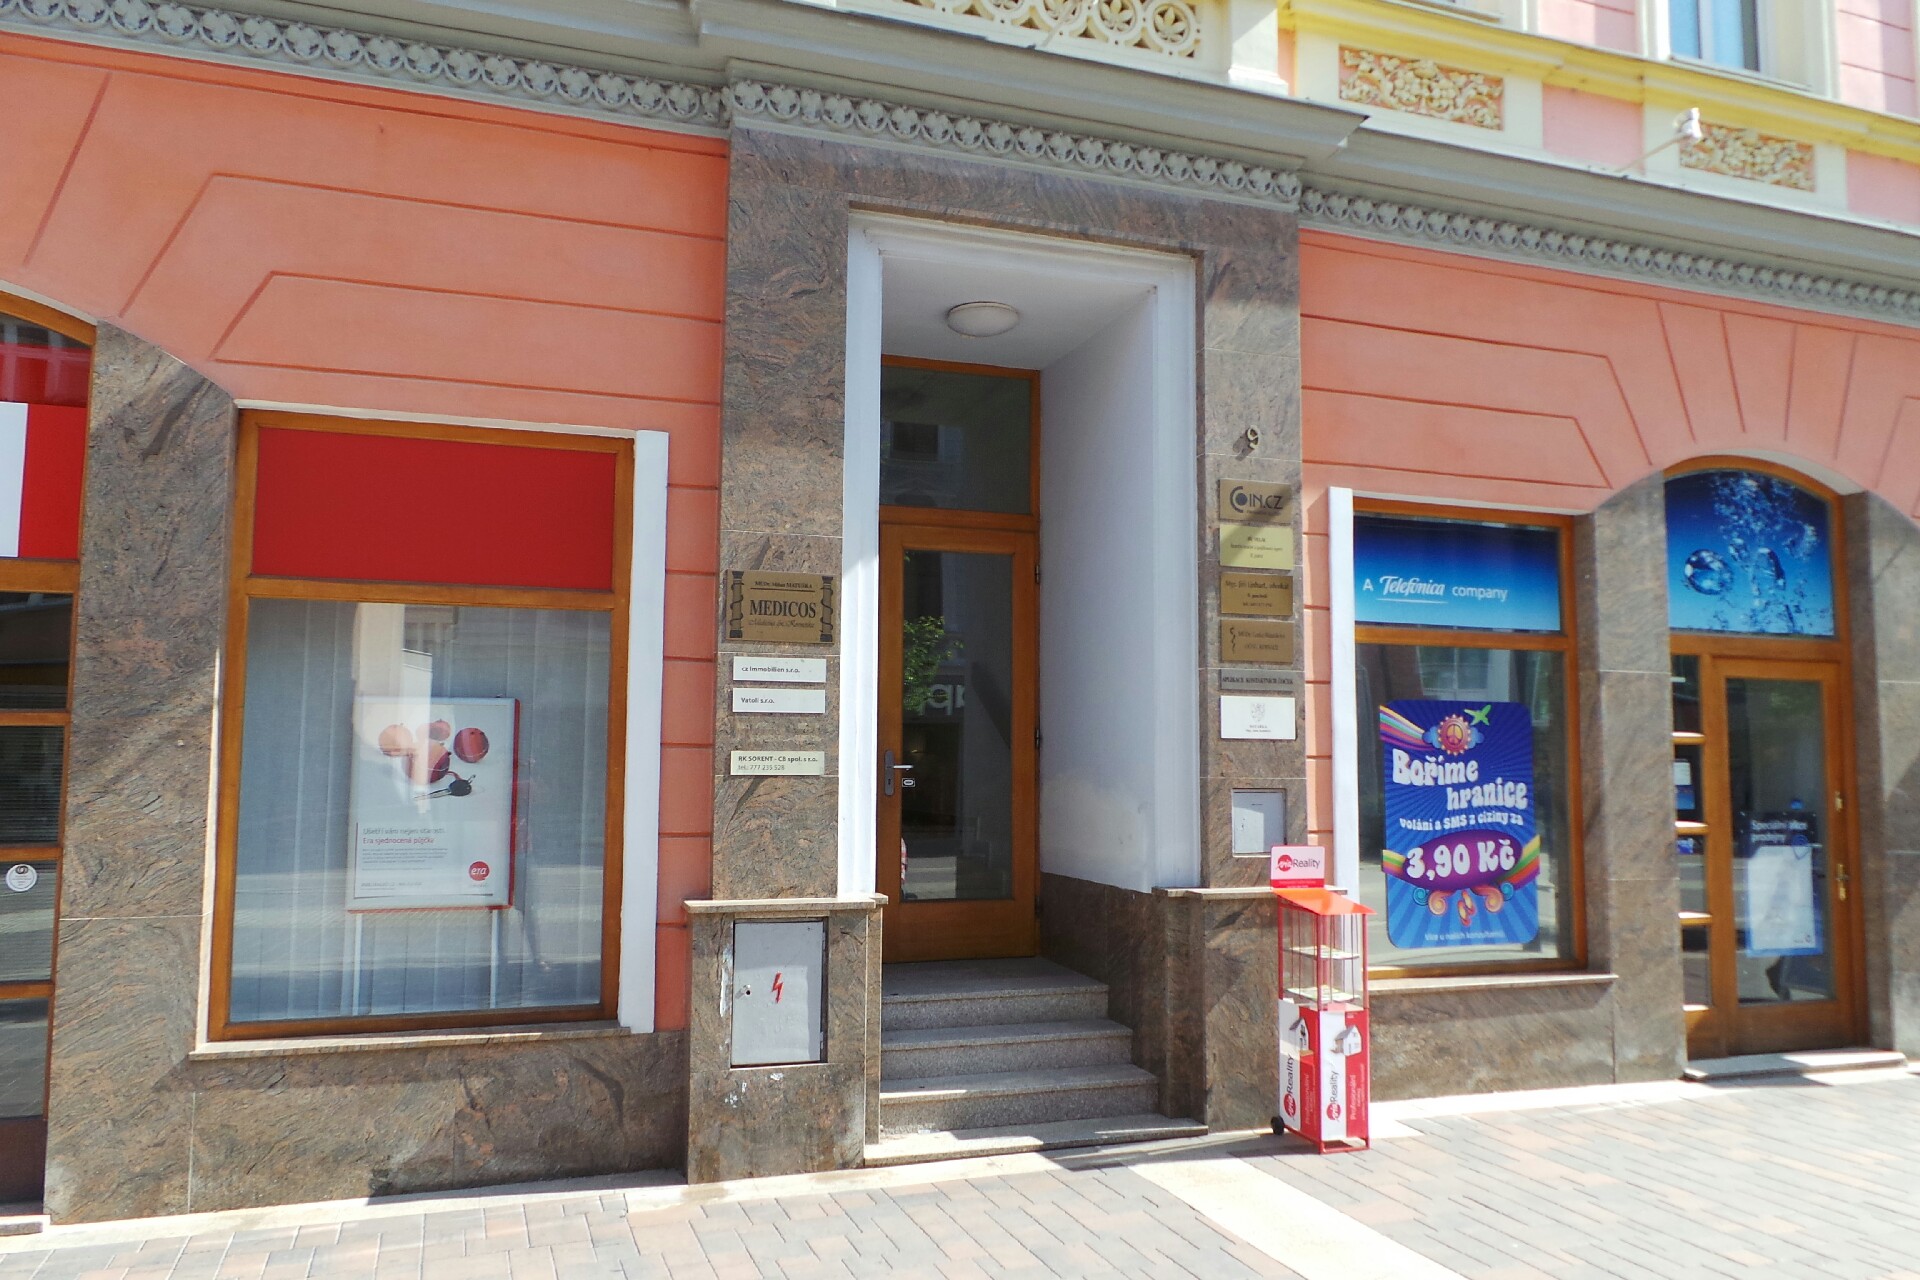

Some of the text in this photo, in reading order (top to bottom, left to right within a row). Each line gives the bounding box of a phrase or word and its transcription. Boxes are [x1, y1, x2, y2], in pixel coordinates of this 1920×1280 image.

[1362, 578, 1374, 591] A
[1451, 585, 1508, 602] company
[749, 599, 816, 619] MEDICOS
[1392, 748, 1479, 786] Boříme
[1446, 777, 1528, 810] hranice
[1434, 820, 1442, 831] a
[1443, 814, 1468, 829] SMS
[1469, 814, 1476, 825] z
[1510, 813, 1524, 826] za
[472, 867, 487, 875] era
[1292, 858, 1321, 869] Reality
[1406, 839, 1516, 880] 3,90 Kč
[1287, 1053, 1295, 1094] Reality
[1329, 1070, 1340, 1103] Reality
